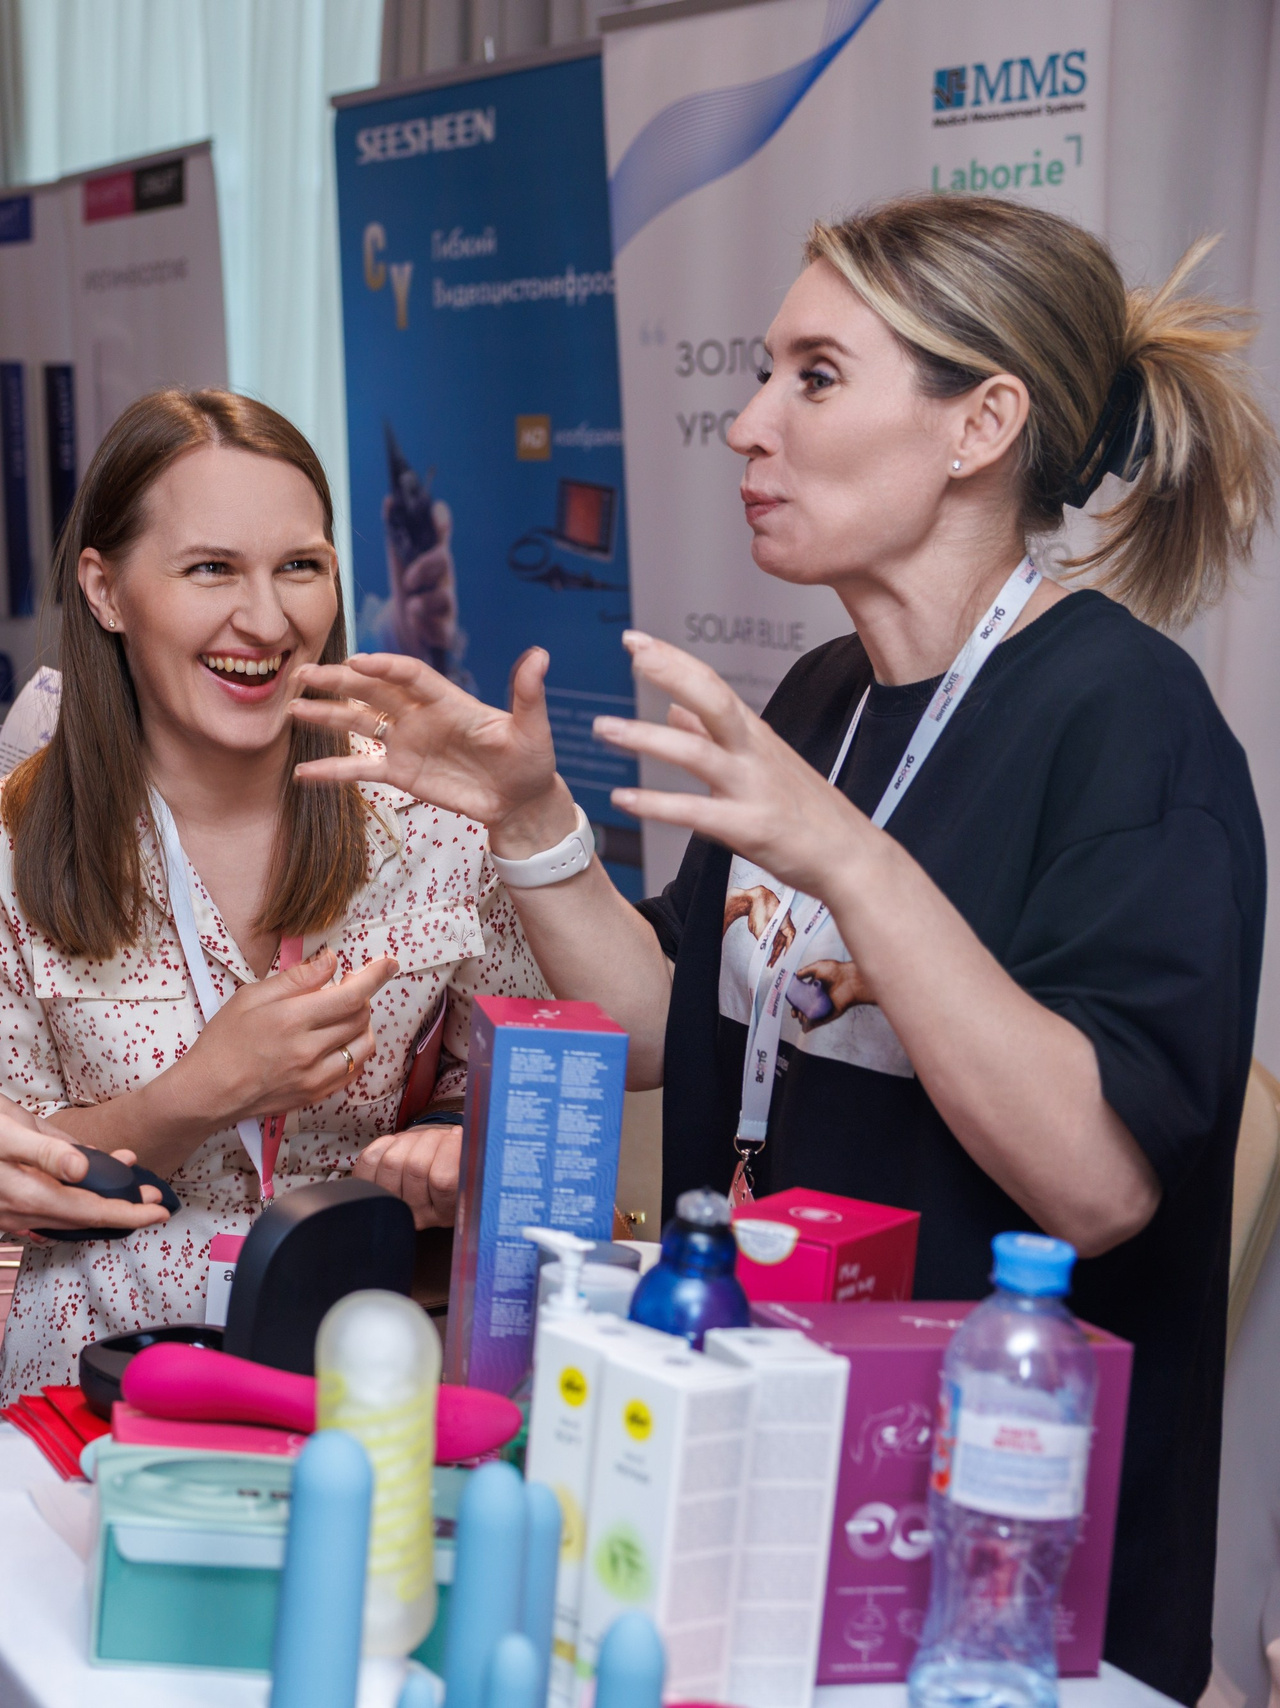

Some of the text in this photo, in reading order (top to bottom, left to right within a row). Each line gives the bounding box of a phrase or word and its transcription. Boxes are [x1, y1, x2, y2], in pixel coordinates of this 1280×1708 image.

[972, 50, 1087, 106] MMS
[356, 105, 496, 165] SEESHEEN
[931, 149, 1065, 194] Laborie
[431, 226, 496, 261] Гибкий
[684, 612, 808, 651] SOLAR BLUE
